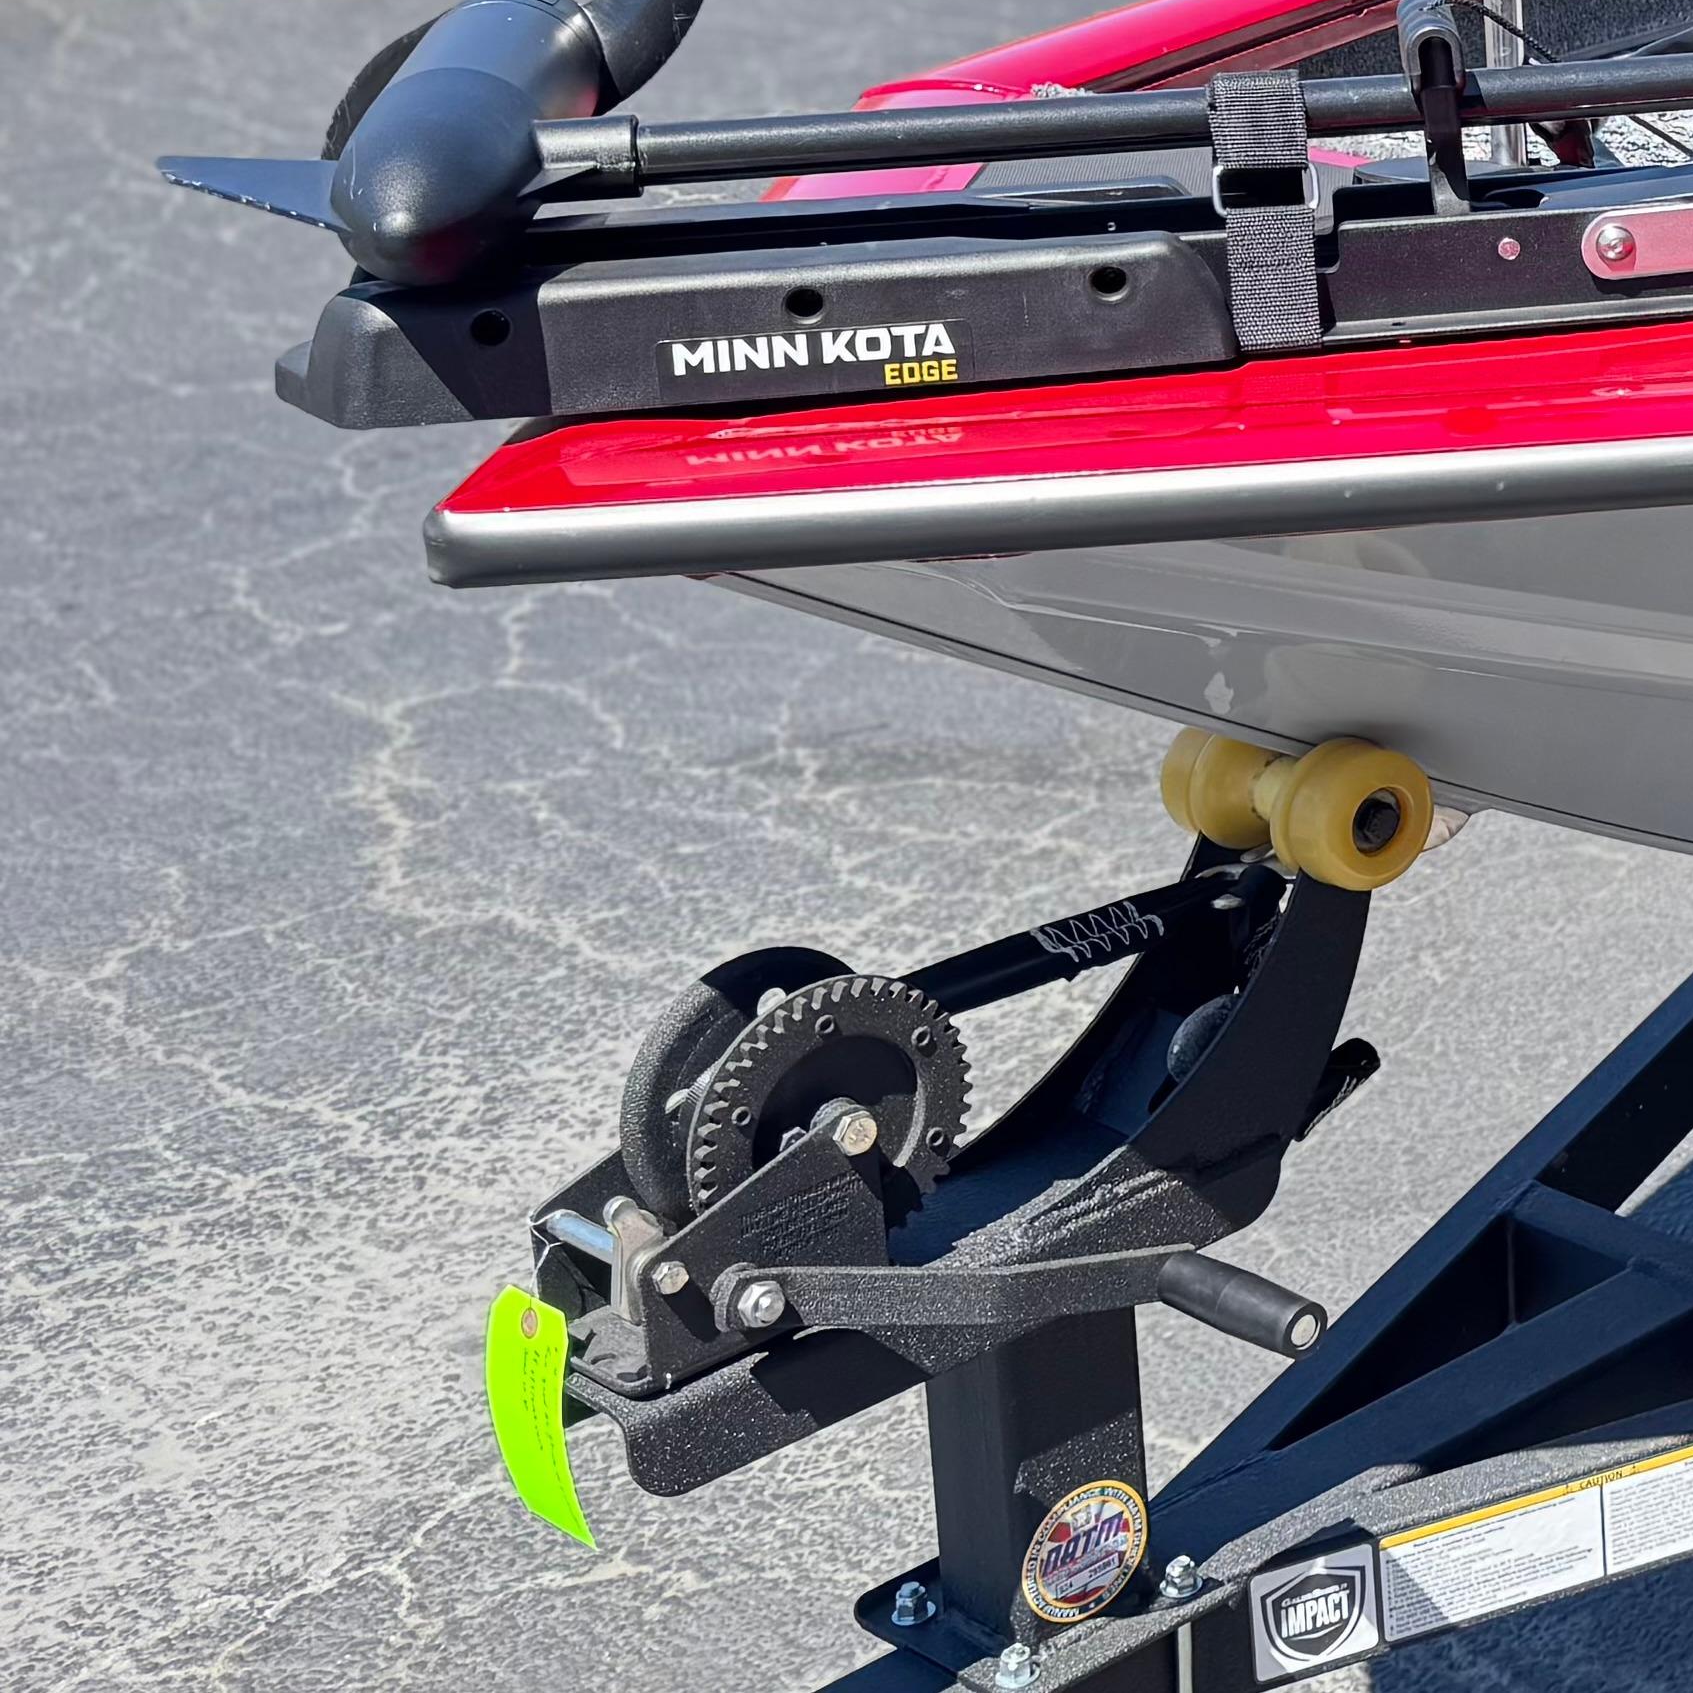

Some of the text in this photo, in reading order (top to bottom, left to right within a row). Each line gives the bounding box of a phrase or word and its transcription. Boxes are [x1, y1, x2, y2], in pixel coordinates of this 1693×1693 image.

[671, 323, 956, 376] MINN KOTA
[884, 359, 958, 385] EDGE
[1579, 1470, 1623, 1491] CAUTION
[1280, 1590, 1350, 1639] IMPACT
